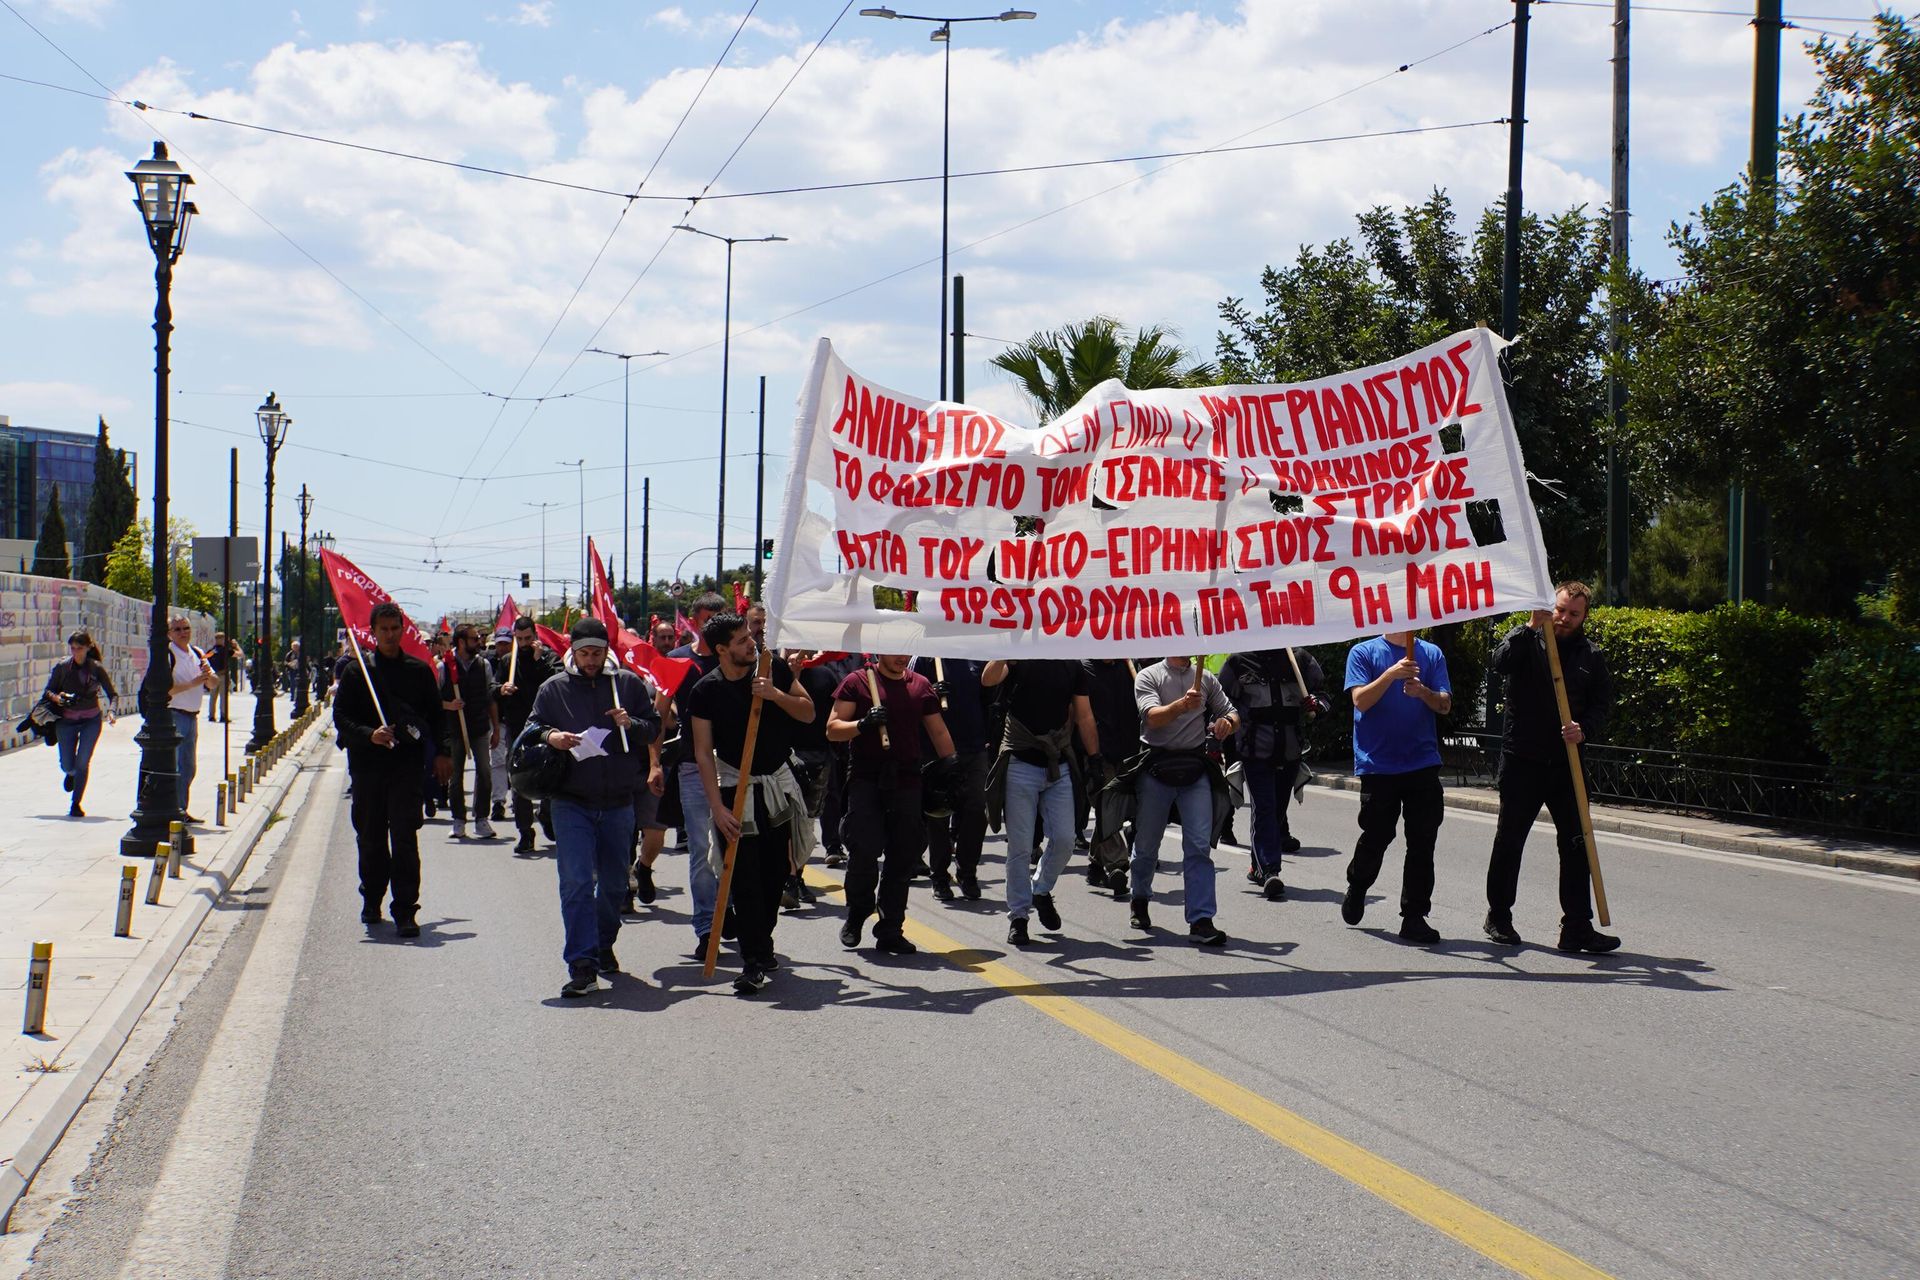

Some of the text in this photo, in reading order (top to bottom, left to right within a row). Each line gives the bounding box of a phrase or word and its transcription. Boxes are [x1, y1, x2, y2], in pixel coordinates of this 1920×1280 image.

[832, 340, 1483, 463] ΑΝΙΚΗΤΟΣ ΔΕΝ ΕΙΝΑΙ Ο ΙΜΠΕΡΙΑΛΙΣΜΟΣ
[868, 462, 1025, 511] ΦΑΣΙΣΜΟ
[1036, 462, 1093, 512] ΤΟΝ
[1102, 455, 1226, 501] ΤΣΑΚΙΣΕ
[1270, 434, 1435, 495] ΚΟΚΚΙΝΟΣ
[1313, 458, 1474, 519] ΣΤΡΑΤΟΣ
[837, 529, 907, 575] ΗΤΤΑ
[919, 537, 984, 580] ΤΟΥ
[1235, 516, 1335, 568] ΣΤΟΥΣ
[1353, 504, 1470, 557] ΛΑΟΥΣ
[940, 561, 1494, 640] ΠΡΩΤΟΒΟΥΛΙΑ ΓΙΑ ΤΗΝ 9Η ΜΑΗ
